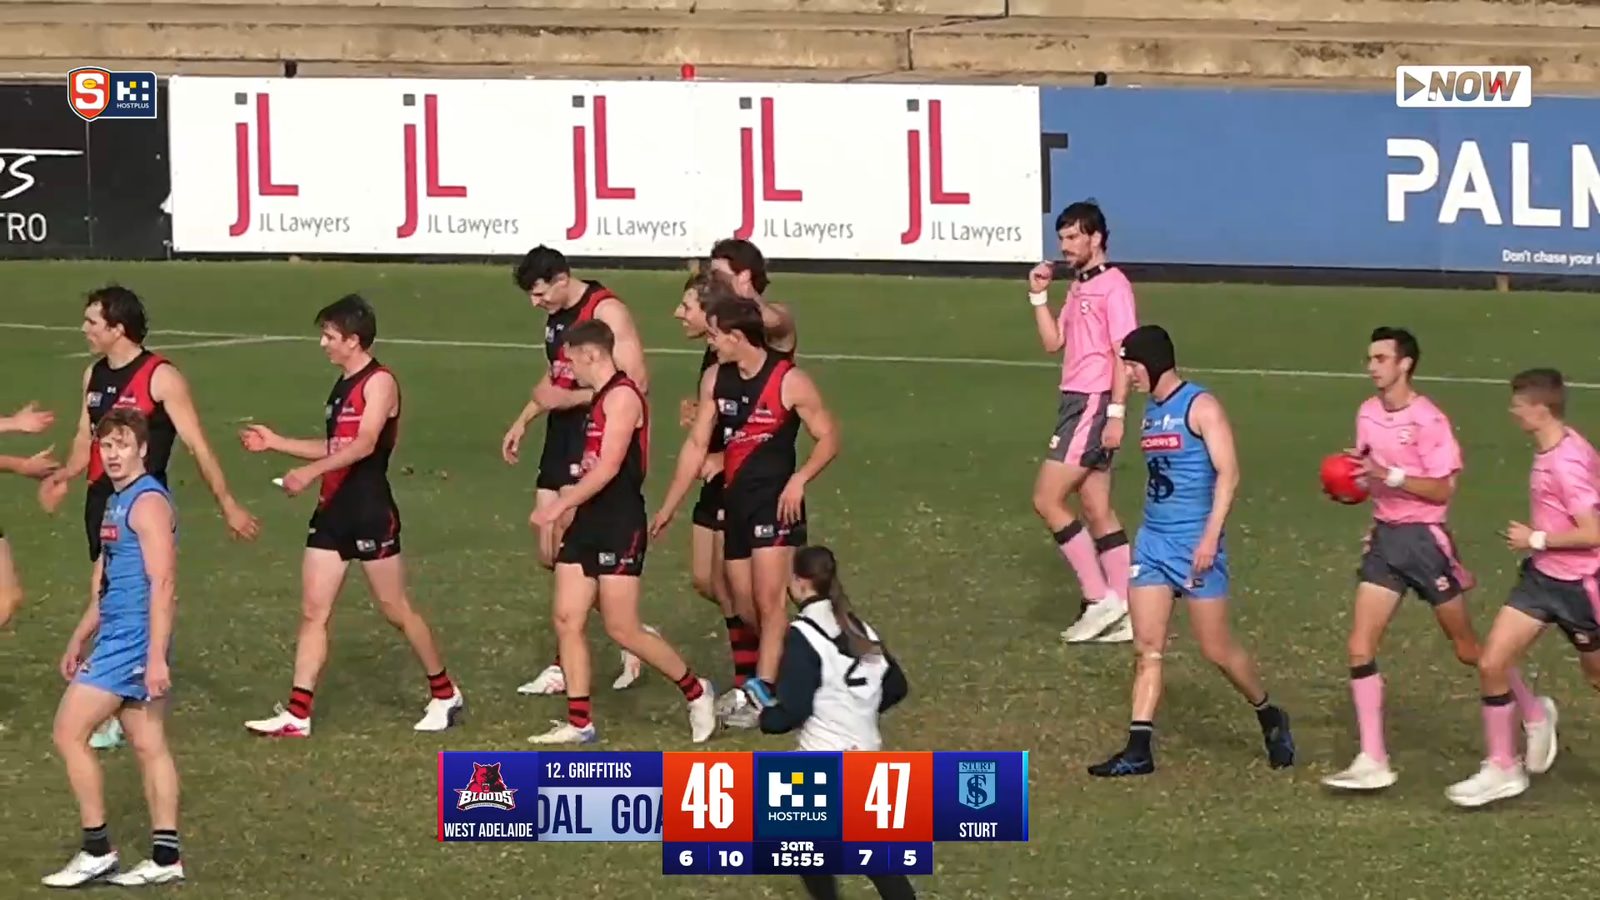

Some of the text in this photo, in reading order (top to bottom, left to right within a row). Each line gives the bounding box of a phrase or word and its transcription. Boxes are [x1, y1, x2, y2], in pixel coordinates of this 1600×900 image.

[0, 212, 48, 242] RO
[259, 213, 350, 238] JL Lawyers
[427, 214, 519, 239] JL Lawyers
[596, 216, 687, 242] JL Lawyers
[763, 218, 854, 244] JL Lawyers
[931, 221, 1022, 247] JL Lawyers
[1502, 249, 1531, 263] Don't
[1533, 250, 1568, 265] chase
[1568, 254, 1594, 268] your
